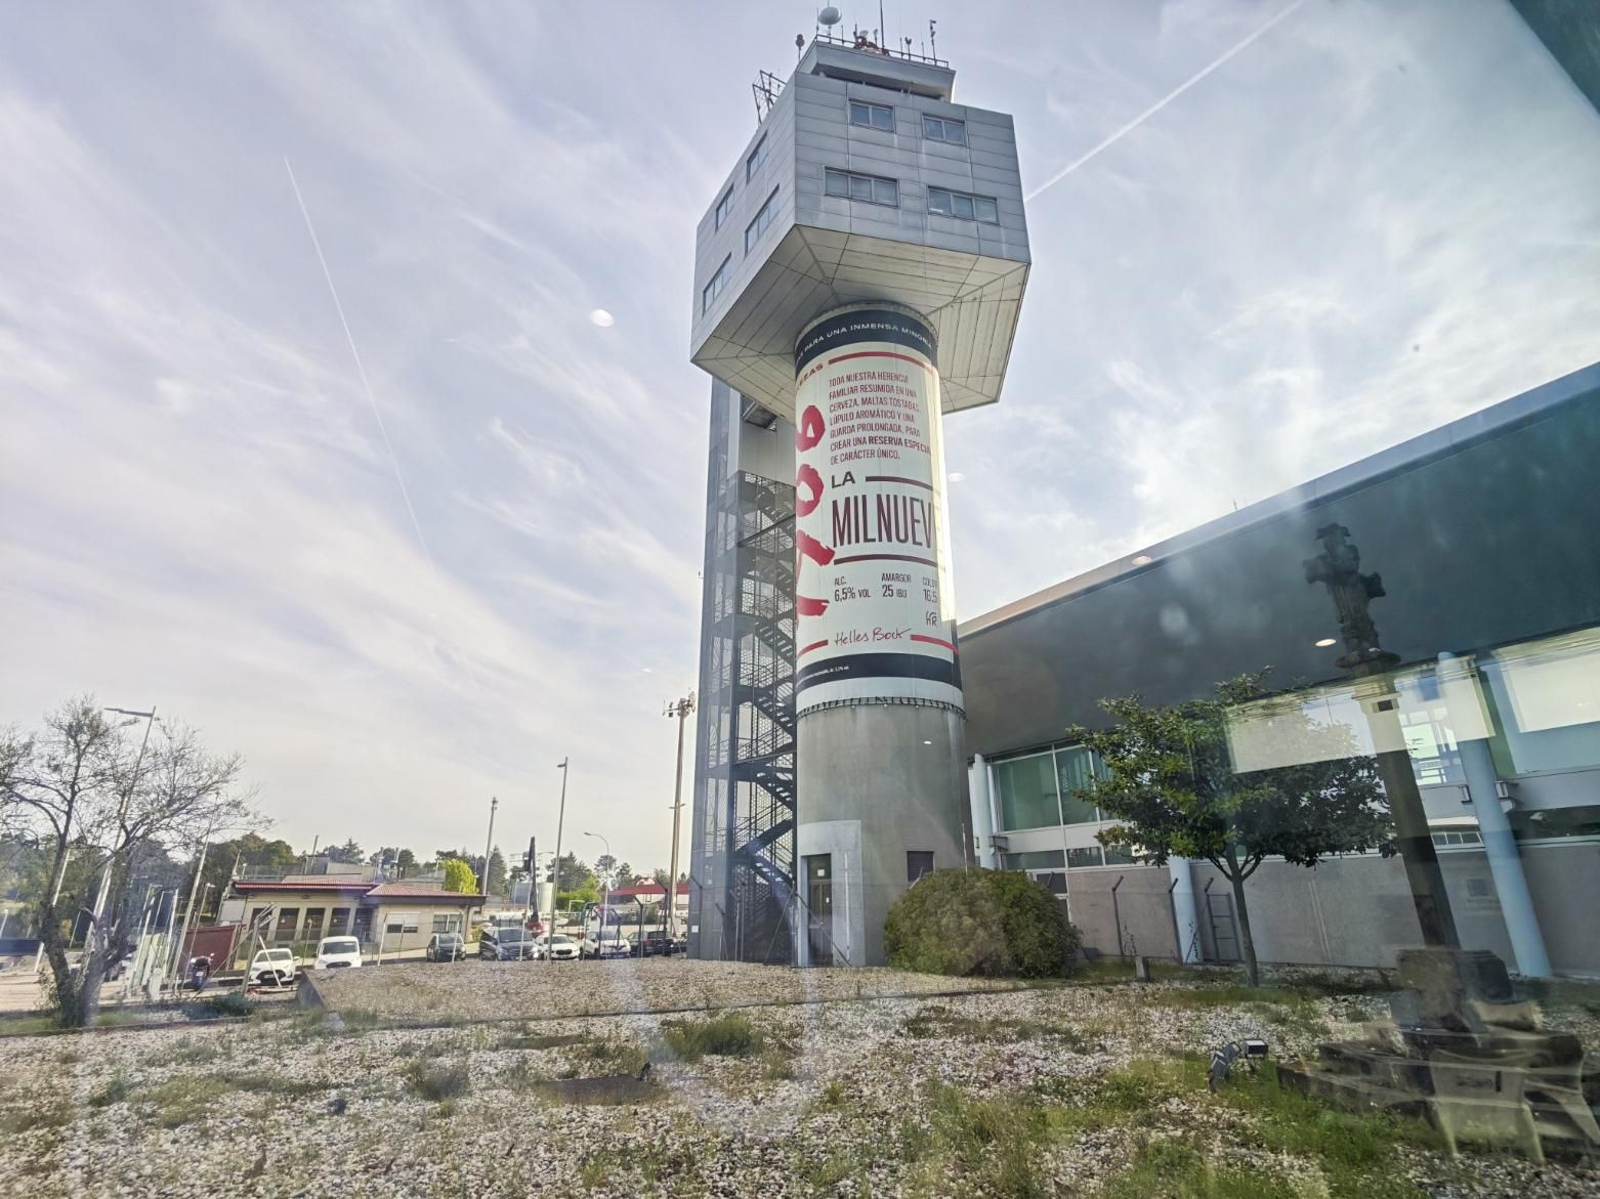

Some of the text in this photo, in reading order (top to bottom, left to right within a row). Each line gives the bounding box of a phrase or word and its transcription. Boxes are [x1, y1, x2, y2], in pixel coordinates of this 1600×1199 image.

[804, 335, 826, 353] PARA
[826, 326, 848, 338] UNA
[850, 323, 899, 332] INMENSA
[829, 371, 909, 388] TODA NUESTRA HERENCIA
[829, 384, 918, 400] FAMILIAR RESUMIDA EN UNA
[861, 396, 888, 407] MALTAS
[830, 408, 916, 426] LÚPULO AROMÁTICO Y UNA
[830, 425, 857, 439] GUARDA
[830, 439, 852, 452] CREAR
[852, 437, 868, 447] UNA
[868, 436, 903, 447] RESERVA
[830, 455, 840, 466] DE
[840, 448, 876, 463] CARÁCTER
[831, 471, 856, 489] LA
[834, 577, 847, 587] ALC.
[881, 572, 912, 584] AMARGOR
[834, 587, 871, 603] 6,5% VOL
[882, 584, 908, 600] 25 IBU
[834, 626, 913, 647] Helles Bock
